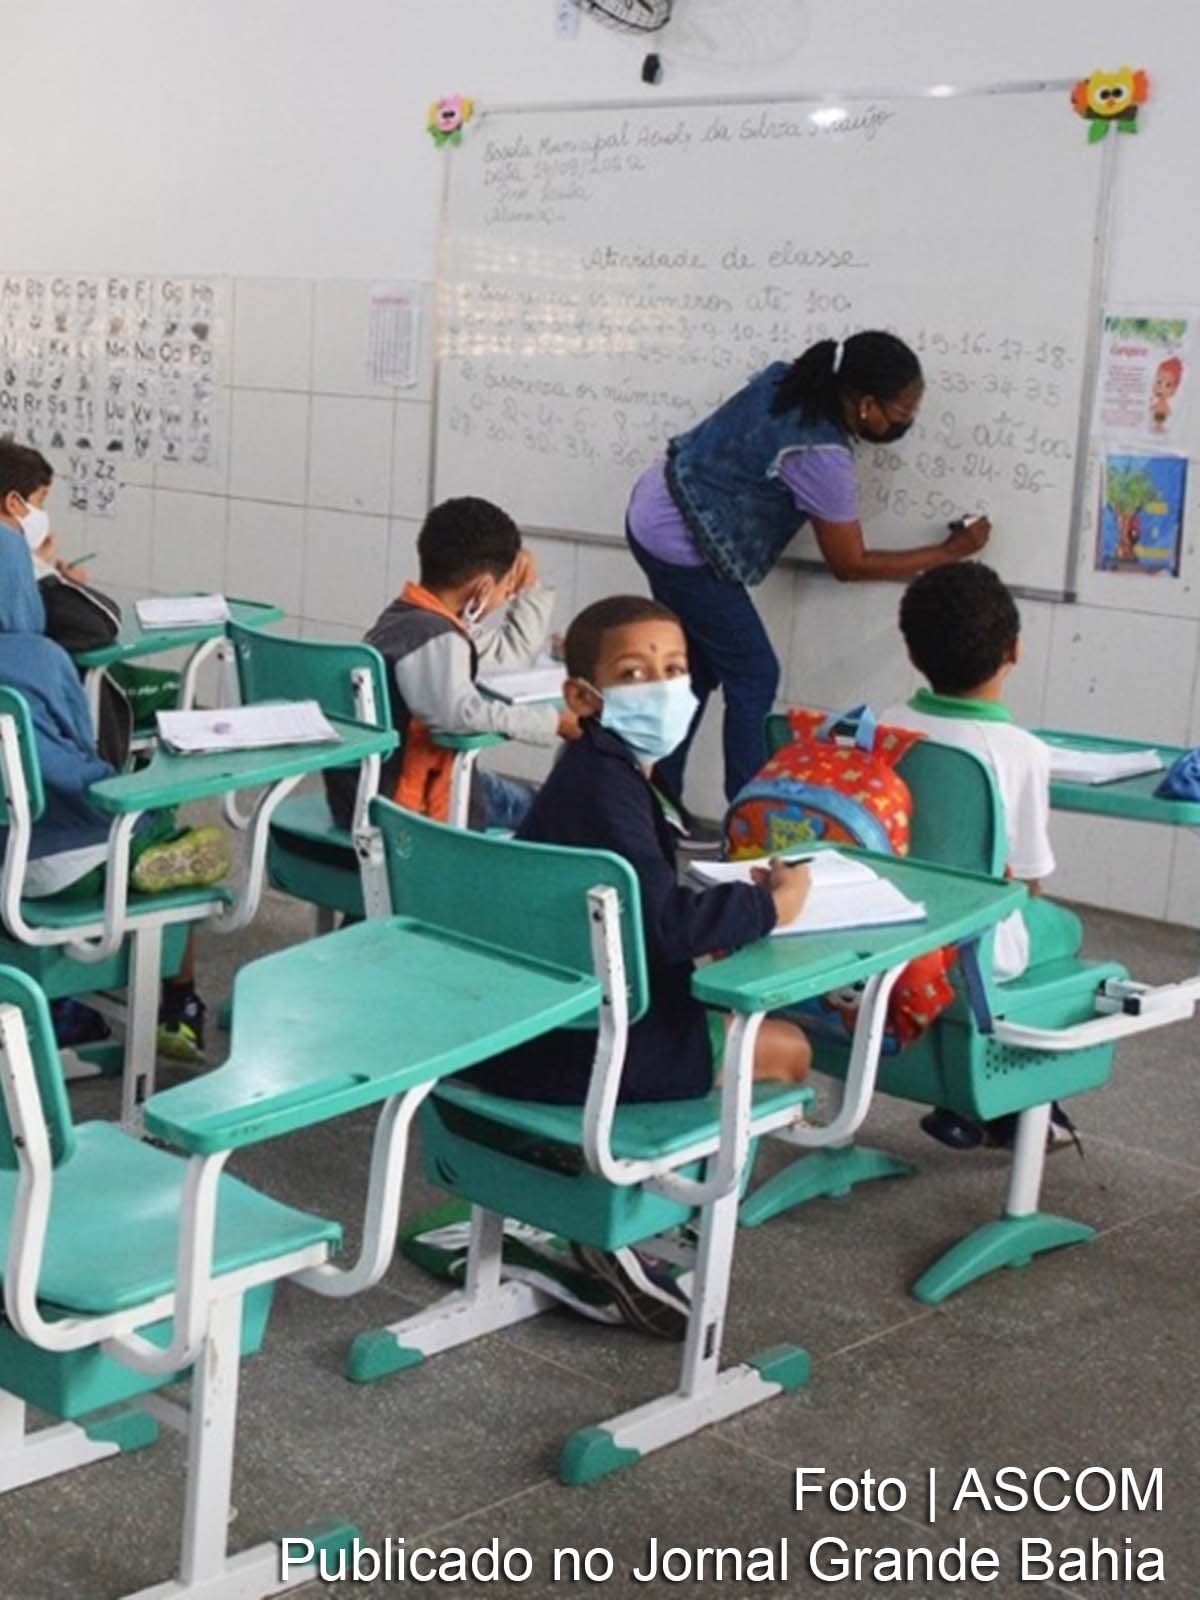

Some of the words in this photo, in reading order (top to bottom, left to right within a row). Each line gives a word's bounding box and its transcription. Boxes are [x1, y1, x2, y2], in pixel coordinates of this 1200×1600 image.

[583, 246, 705, 270] Atividade
[720, 245, 755, 270] de
[767, 240, 870, 270] classe
